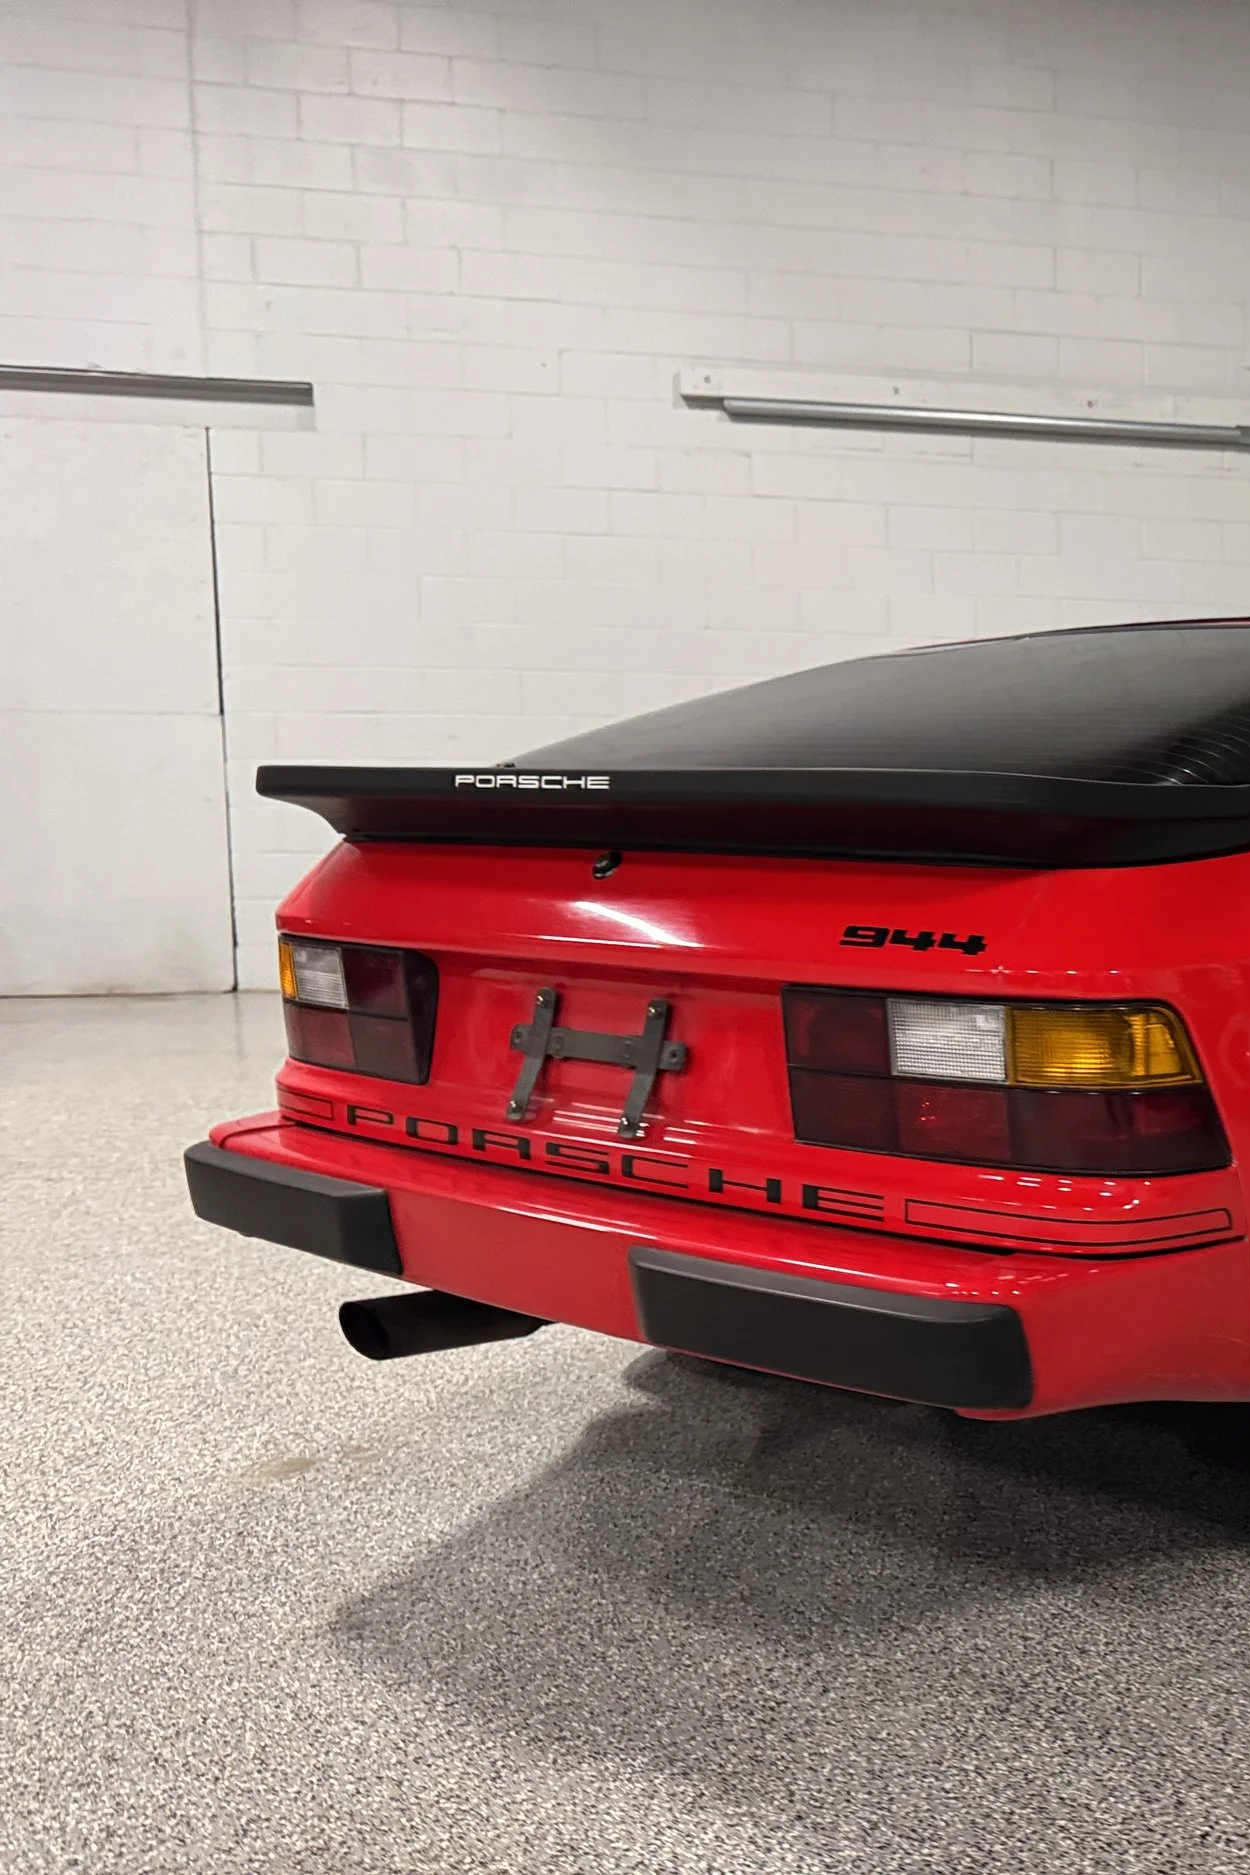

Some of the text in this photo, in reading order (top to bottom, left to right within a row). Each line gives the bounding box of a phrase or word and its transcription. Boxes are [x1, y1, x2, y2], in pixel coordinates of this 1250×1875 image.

[454, 774, 611, 789] PORSCHE
[839, 925, 988, 956] 944
[347, 1103, 884, 1222] PORSCHE
